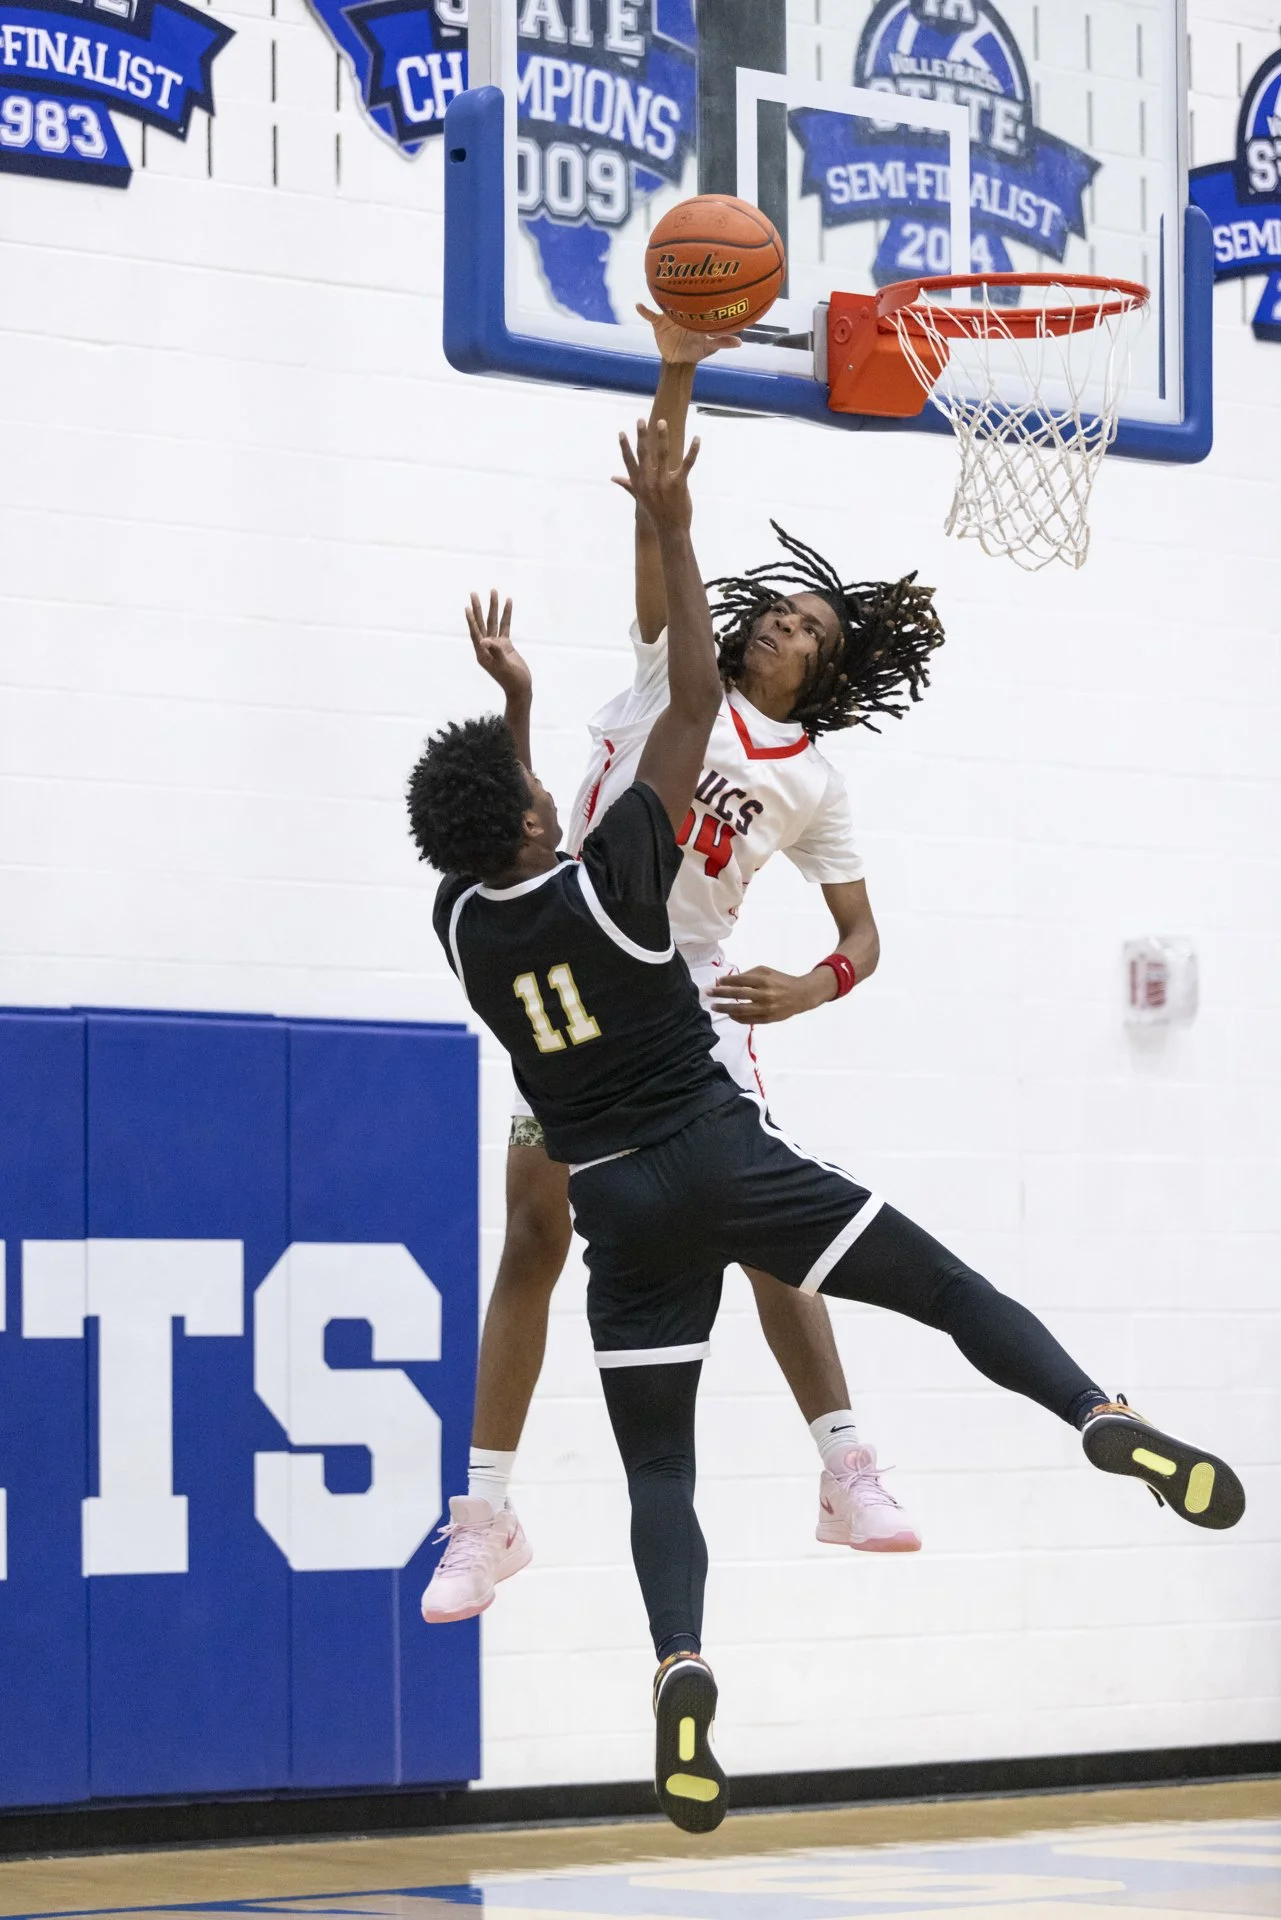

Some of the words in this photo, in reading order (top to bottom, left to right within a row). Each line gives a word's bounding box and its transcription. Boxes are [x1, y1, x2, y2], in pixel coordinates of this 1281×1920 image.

[396, 52, 681, 160] CHMPIONS
[517, 139, 629, 223] 009
[826, 160, 1063, 238] SEMI-FIALIST
[654, 252, 741, 279] Baden
[896, 222, 997, 275] 204
[718, 301, 747, 320] PRO
[693, 768, 764, 836] UCS
[513, 963, 602, 1054] 11
[0, 1239, 443, 1578] TS
